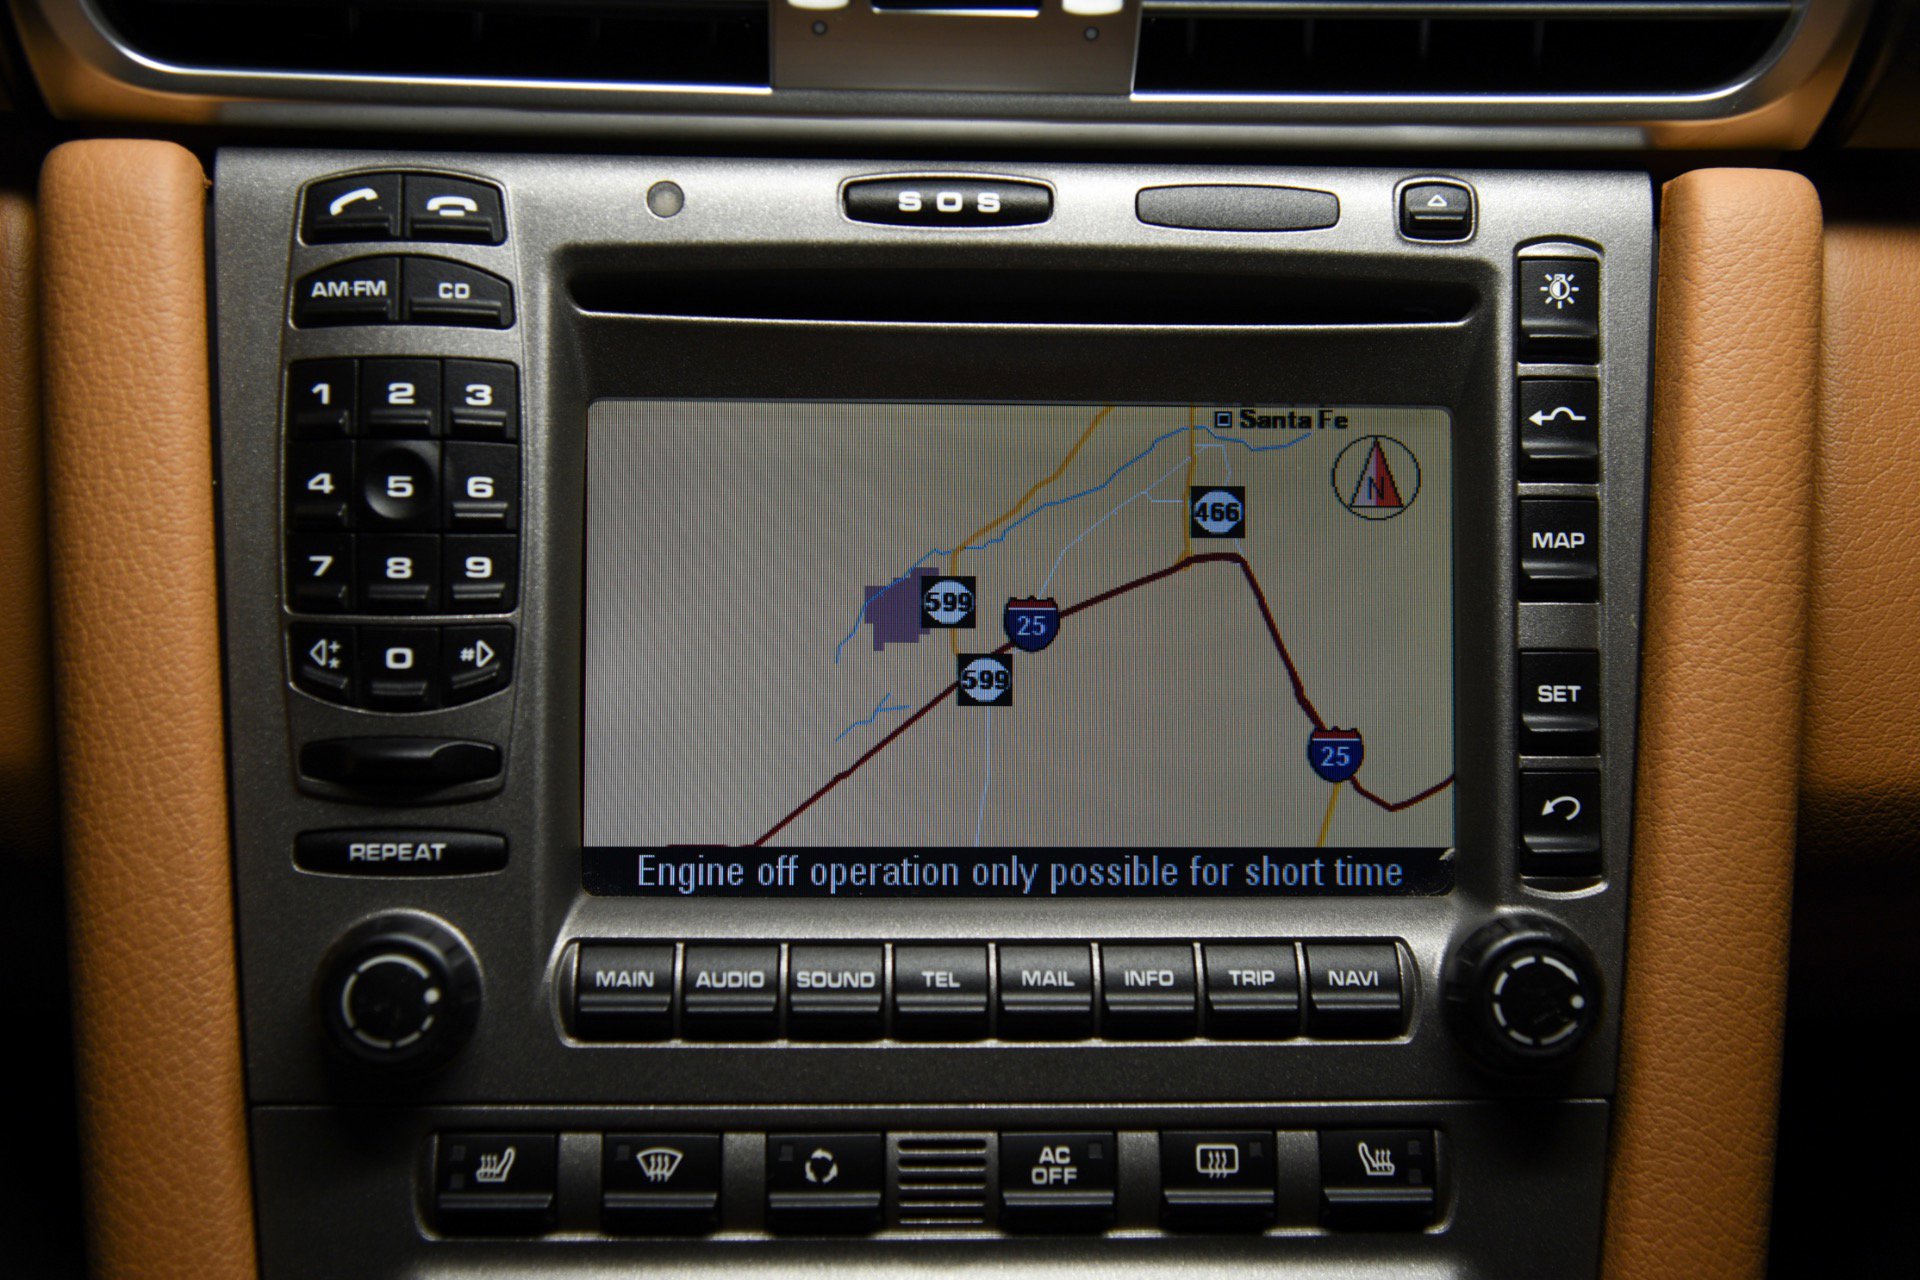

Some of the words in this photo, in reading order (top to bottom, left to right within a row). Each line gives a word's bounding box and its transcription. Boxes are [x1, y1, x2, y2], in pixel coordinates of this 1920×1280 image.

[438, 283, 470, 299] CD
[311, 383, 330, 404] 1
[388, 383, 415, 404] 2
[465, 384, 492, 406] 3
[1239, 410, 1312, 429] Santa
[1318, 410, 1349, 429] Fe
[307, 473, 335, 494] 4
[386, 475, 414, 497] 5
[467, 476, 494, 498] 6
[1368, 477, 1385, 500] N
[1195, 502, 1241, 522] 466
[1532, 532, 1585, 549] MAP
[308, 555, 333, 577] 7
[386, 556, 412, 579] 8
[465, 556, 492, 578] 9
[925, 592, 974, 612] 599
[1017, 616, 1046, 636] 25
[961, 670, 1009, 690] 599
[1538, 685, 1581, 703] SET
[1320, 746, 1350, 767] 25
[349, 843, 446, 861] REPEAT
[638, 854, 743, 895] Engine
[758, 854, 799, 886] off
[810, 854, 959, 894] operation
[973, 855, 1038, 894] only
[1050, 855, 1178, 894] possible
[1190, 855, 1234, 886] for
[1245, 855, 1325, 886] short
[1335, 855, 1402, 886] time
[594, 971, 655, 988] MAIN
[695, 971, 765, 989] AUDIO
[796, 971, 875, 989] SOUND
[922, 971, 960, 988] TEL
[1021, 971, 1075, 987] MAIL
[1124, 970, 1174, 987] INFO
[1228, 970, 1275, 987] TRIP
[1328, 970, 1379, 986] NAVI
[1039, 1146, 1071, 1164] AC
[1031, 1167, 1077, 1185] OFF
